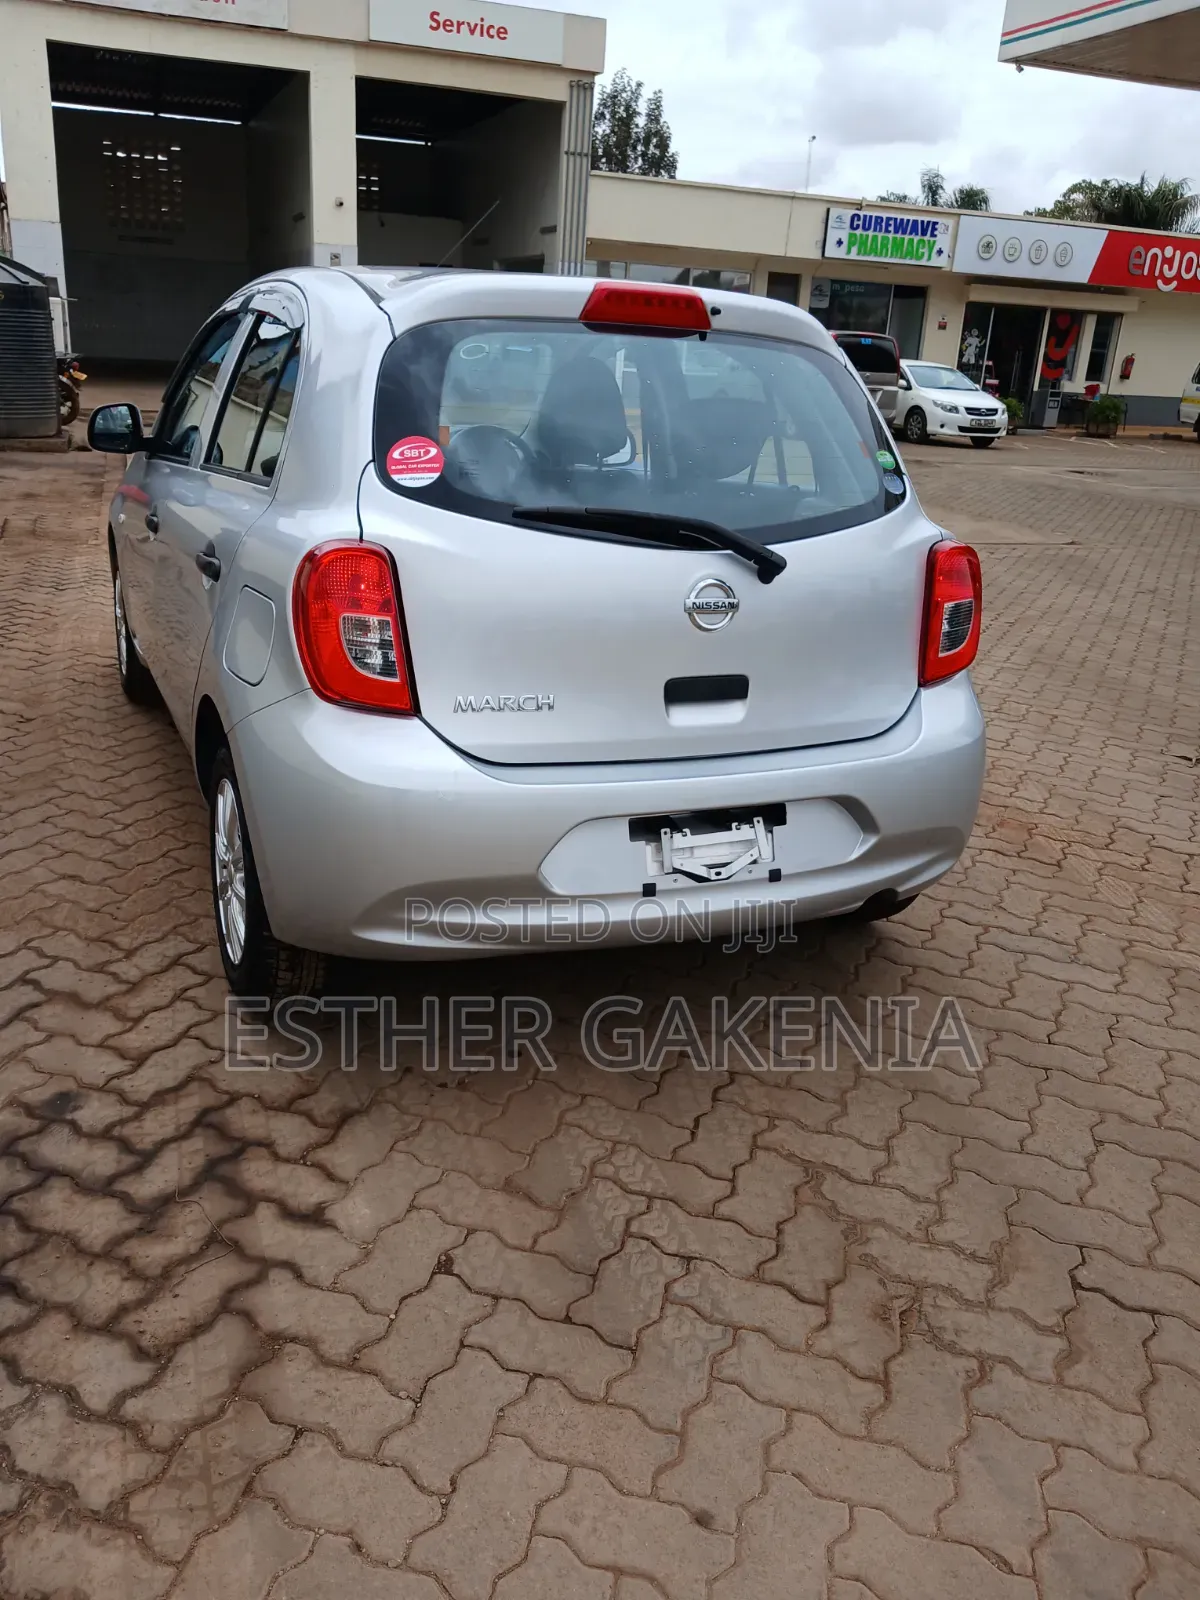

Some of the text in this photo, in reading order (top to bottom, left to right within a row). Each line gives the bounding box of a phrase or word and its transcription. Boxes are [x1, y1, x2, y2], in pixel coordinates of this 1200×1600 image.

[428, 10, 508, 41] Service
[849, 213, 939, 238] CUREWAVE
[845, 232, 937, 262] PHARMACY
[403, 448, 426, 458] SBT
[691, 601, 736, 610] NISSAN
[453, 693, 555, 713] MARCH
